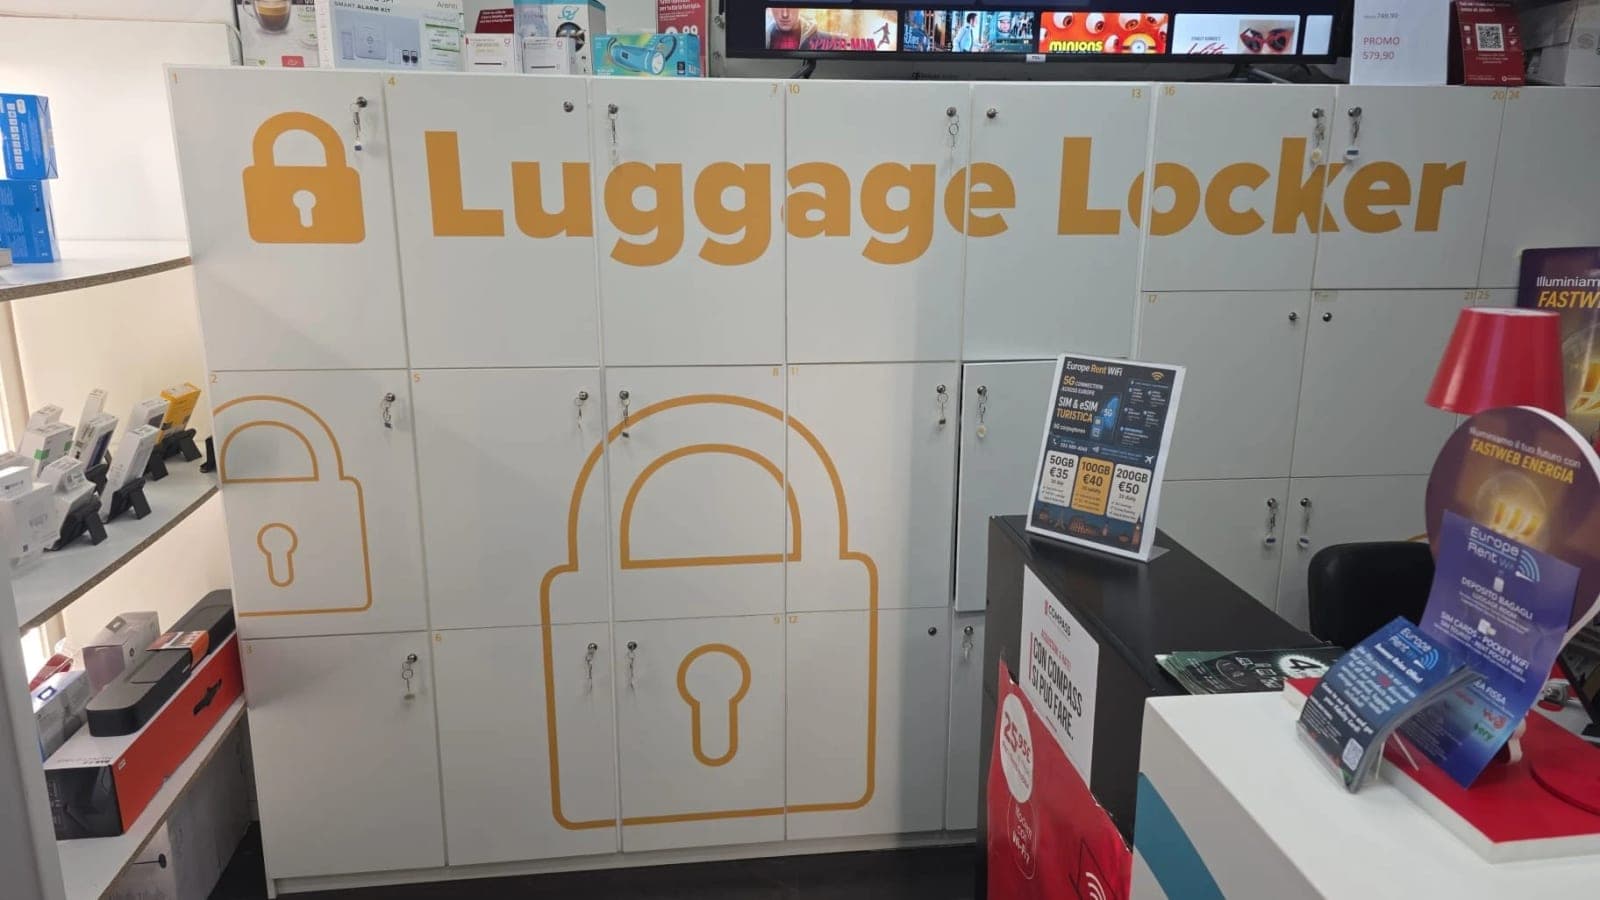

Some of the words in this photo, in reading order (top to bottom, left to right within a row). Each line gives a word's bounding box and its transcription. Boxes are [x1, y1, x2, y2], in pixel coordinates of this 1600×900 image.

[357, 4, 379, 12] ALARM
[809, 37, 876, 50] SPIDER-MAN
[1363, 36, 1400, 46] PROMO
[1362, 51, 1395, 61] 579,90
[388, 77, 396, 87] 4
[788, 84, 800, 95] 10
[1131, 88, 1142, 99] 13
[1164, 86, 1176, 97] 16
[424, 130, 1016, 266] Luggage
[1058, 136, 1467, 237] Locker
[1538, 290, 1600, 309] FASTW
[1066, 360, 1090, 372] Europe
[1090, 363, 1107, 374] Rent
[211, 375, 218, 384] 2
[414, 373, 421, 382] 5
[1062, 375, 1076, 386] 5G
[1058, 396, 1072, 408] SIM
[1079, 401, 1098, 412] eSIM
[1056, 408, 1093, 424] TURISTICA
[1050, 455, 1074, 468] 50GB
[1470, 439, 1521, 465] FASTWEB
[1521, 455, 1574, 484] ENERGIA
[1520, 442, 1536, 454] tuo
[1564, 458, 1581, 468] con
[1050, 467, 1068, 480] €35
[1082, 461, 1110, 476] 100GB
[1083, 474, 1103, 487] €40
[1116, 468, 1148, 484] 200GB
[1118, 482, 1140, 495] €50
[1470, 526, 1520, 557] Europe
[1467, 541, 1497, 564] Rent
[1461, 576, 1498, 601] DEPOSITO
[1498, 596, 1534, 620] BAGAGLI
[1048, 604, 1071, 637] COMPASS
[1454, 620, 1478, 637] CARDS
[1482, 636, 1512, 658] POCKET
[1288, 658, 1322, 671] 4
[1032, 637, 1047, 668] CON
[1048, 655, 1083, 718] COMPASS
[1031, 664, 1039, 689] SI
[1053, 697, 1074, 741] FARE.
[1486, 686, 1507, 705] FISSA
